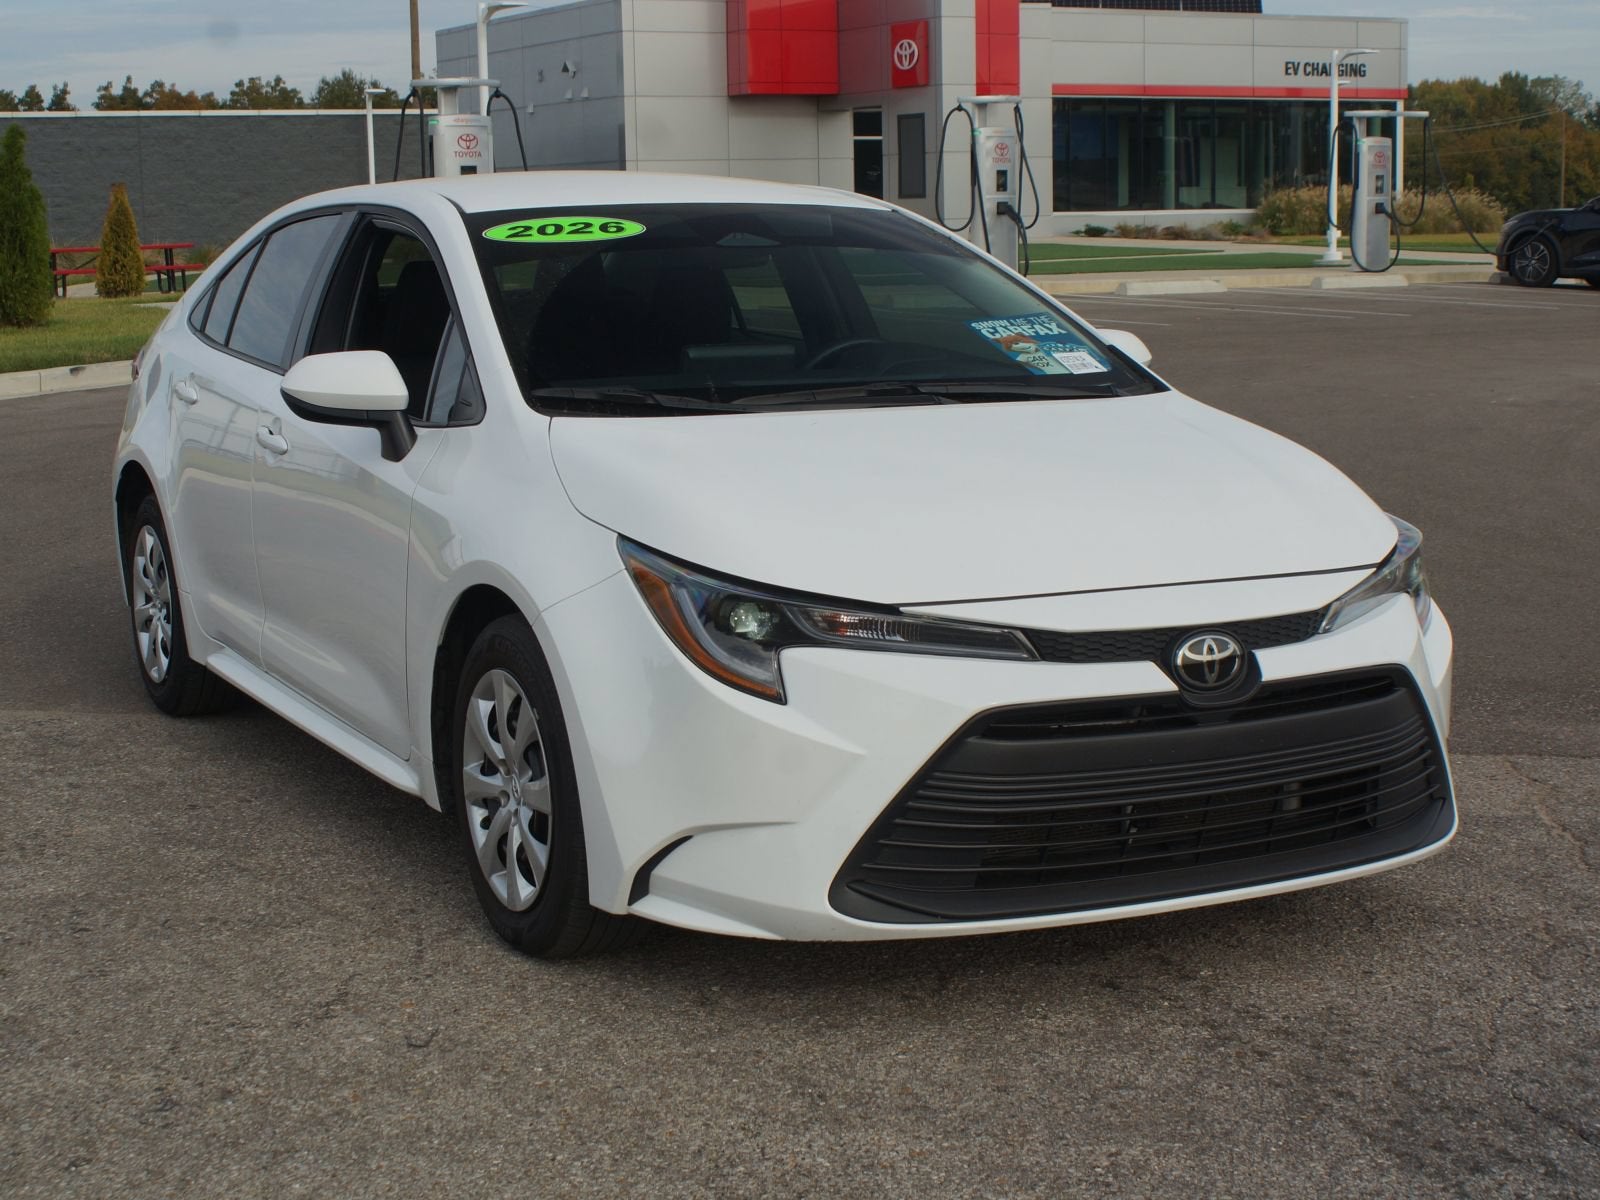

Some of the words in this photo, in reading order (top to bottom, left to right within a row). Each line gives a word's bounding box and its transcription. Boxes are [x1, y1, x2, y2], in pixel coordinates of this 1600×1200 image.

[1285, 61, 1300, 76] EV
[453, 150, 482, 158] TOYOTA
[505, 221, 625, 239] 2026
[971, 319, 1010, 330] SHOW
[981, 322, 1068, 339] CARFAX
